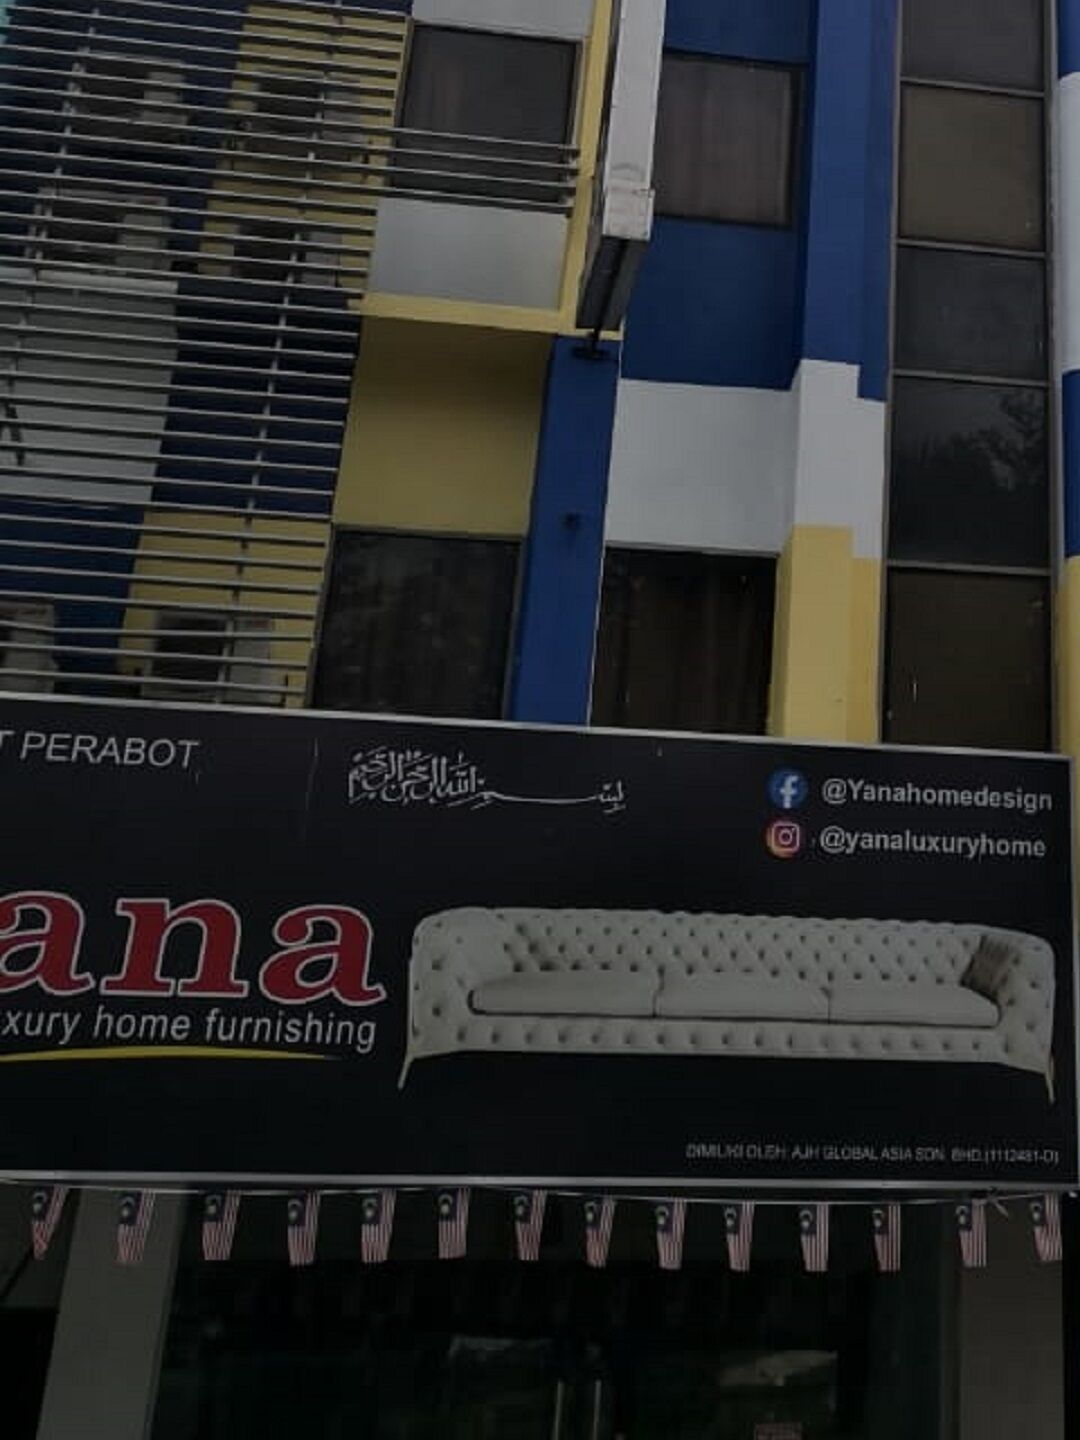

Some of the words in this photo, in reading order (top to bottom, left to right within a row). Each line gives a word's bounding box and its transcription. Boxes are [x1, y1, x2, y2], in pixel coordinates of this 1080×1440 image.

[19, 730, 201, 769] PERABOT
[822, 777, 1052, 814] @Yanahomedesign
[819, 824, 1047, 859] @yanaluxuryhome
[93, 1005, 191, 1040] home
[204, 1007, 378, 1055] furnishing
[822, 1144, 879, 1161] GLOBAL
[880, 1145, 913, 1162] ASIA
